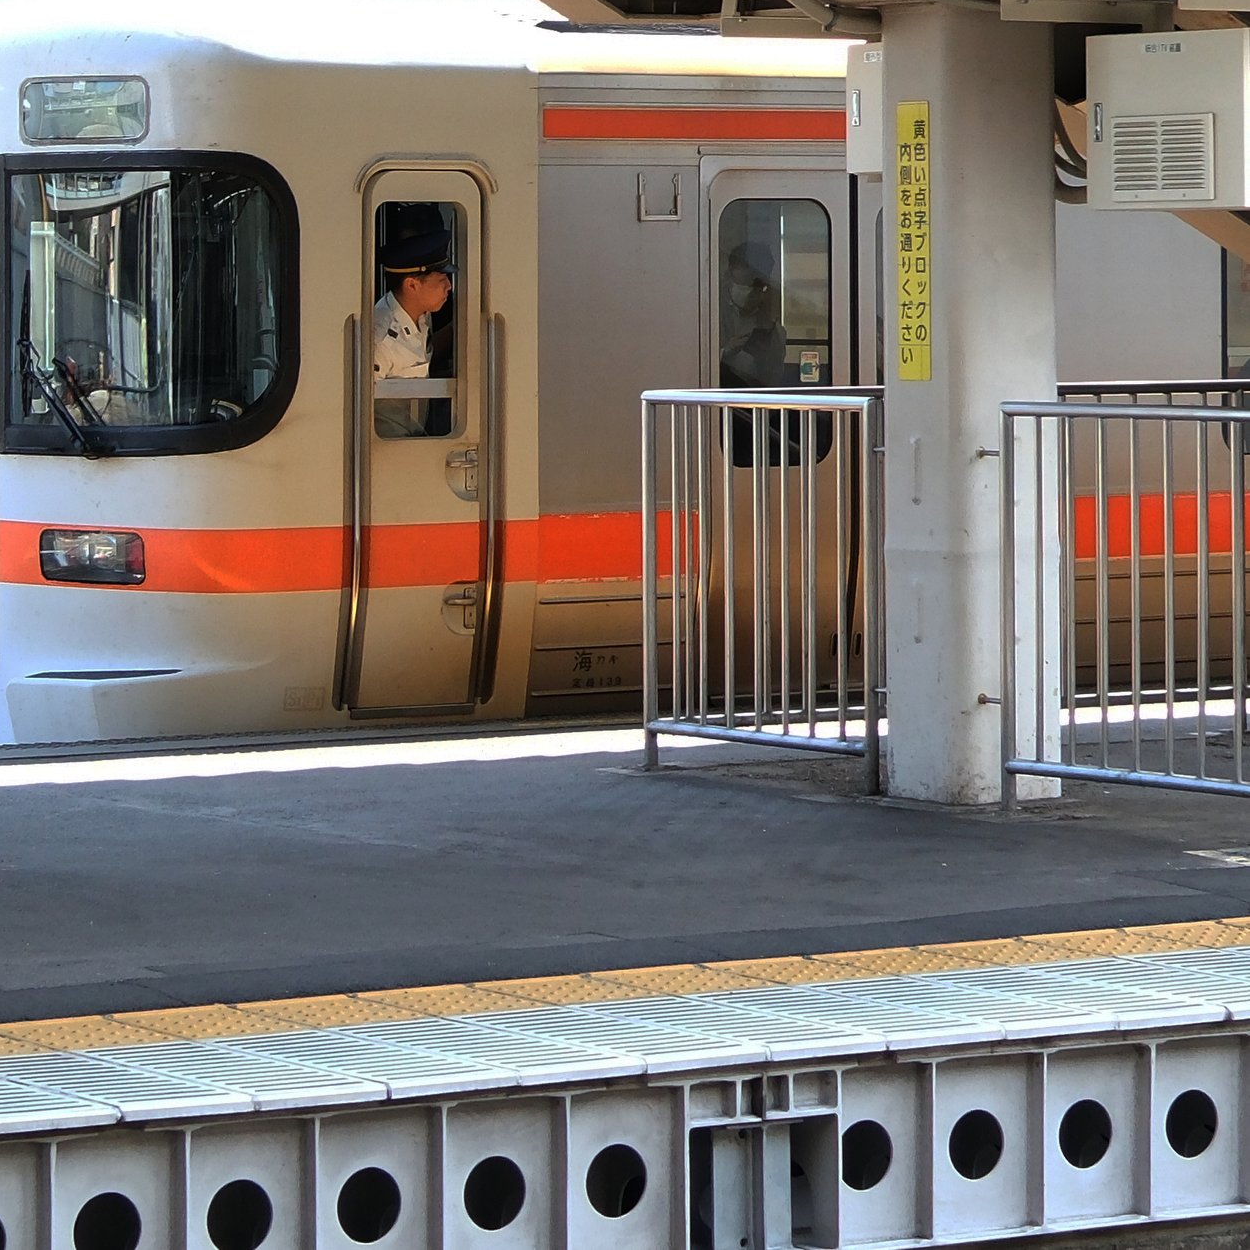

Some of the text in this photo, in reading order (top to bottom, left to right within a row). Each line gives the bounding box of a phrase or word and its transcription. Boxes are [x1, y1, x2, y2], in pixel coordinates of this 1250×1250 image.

[899, 142, 914, 364] 内側をお通りください
[913, 119, 928, 342] 黄色い点字ブロックの
[572, 650, 593, 672] 海
